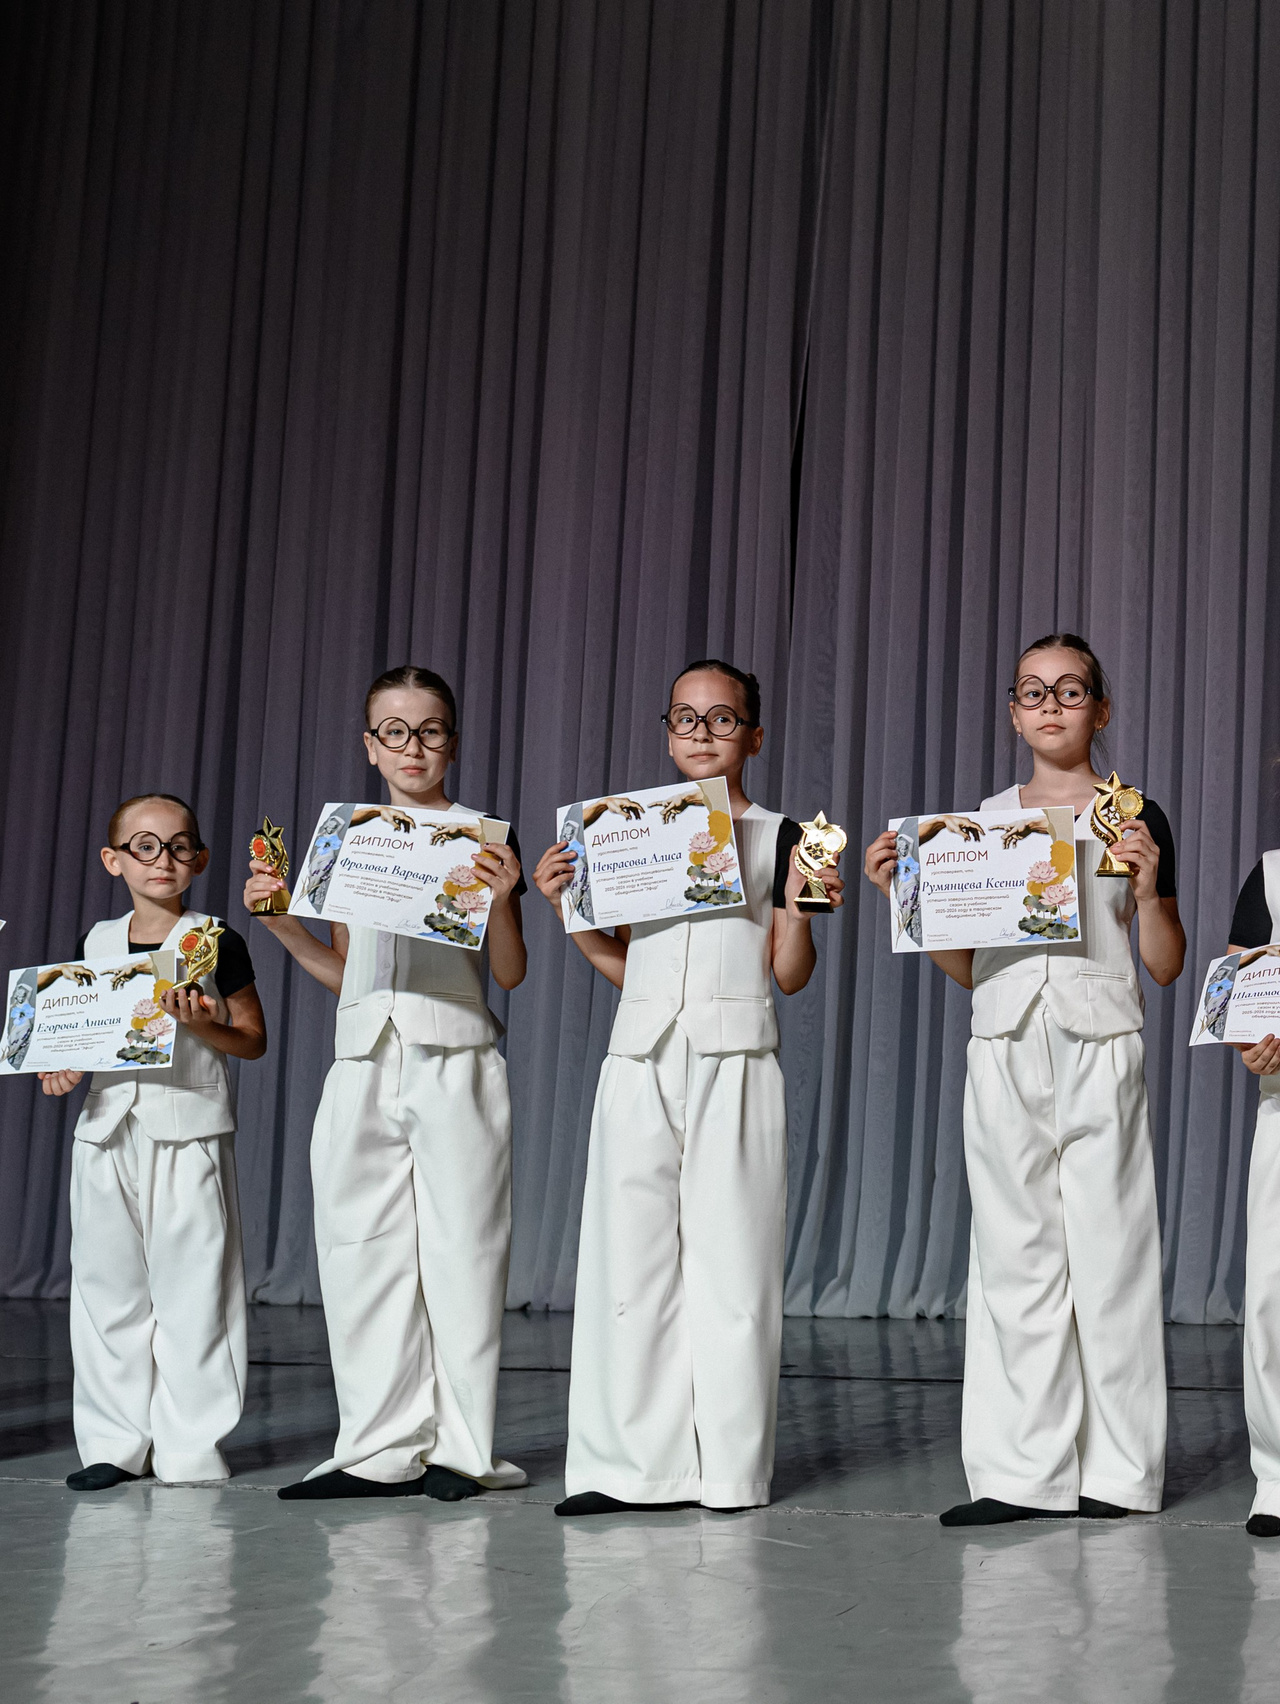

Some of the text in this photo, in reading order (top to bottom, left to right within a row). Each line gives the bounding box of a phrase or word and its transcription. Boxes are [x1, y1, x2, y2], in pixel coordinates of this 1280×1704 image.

[349, 834, 414, 851] ДИПЛОМ
[592, 827, 650, 848] ДИПЛОМ
[593, 852, 682, 873] Некрасова Алиса
[926, 850, 988, 866] ДИПЛОМ
[340, 858, 439, 885] Фролова Варвара
[922, 877, 1025, 896] Румянцева Ксения
[42, 993, 99, 1010] ДИПЛОМ
[37, 1017, 122, 1034] Егорова Анисия
